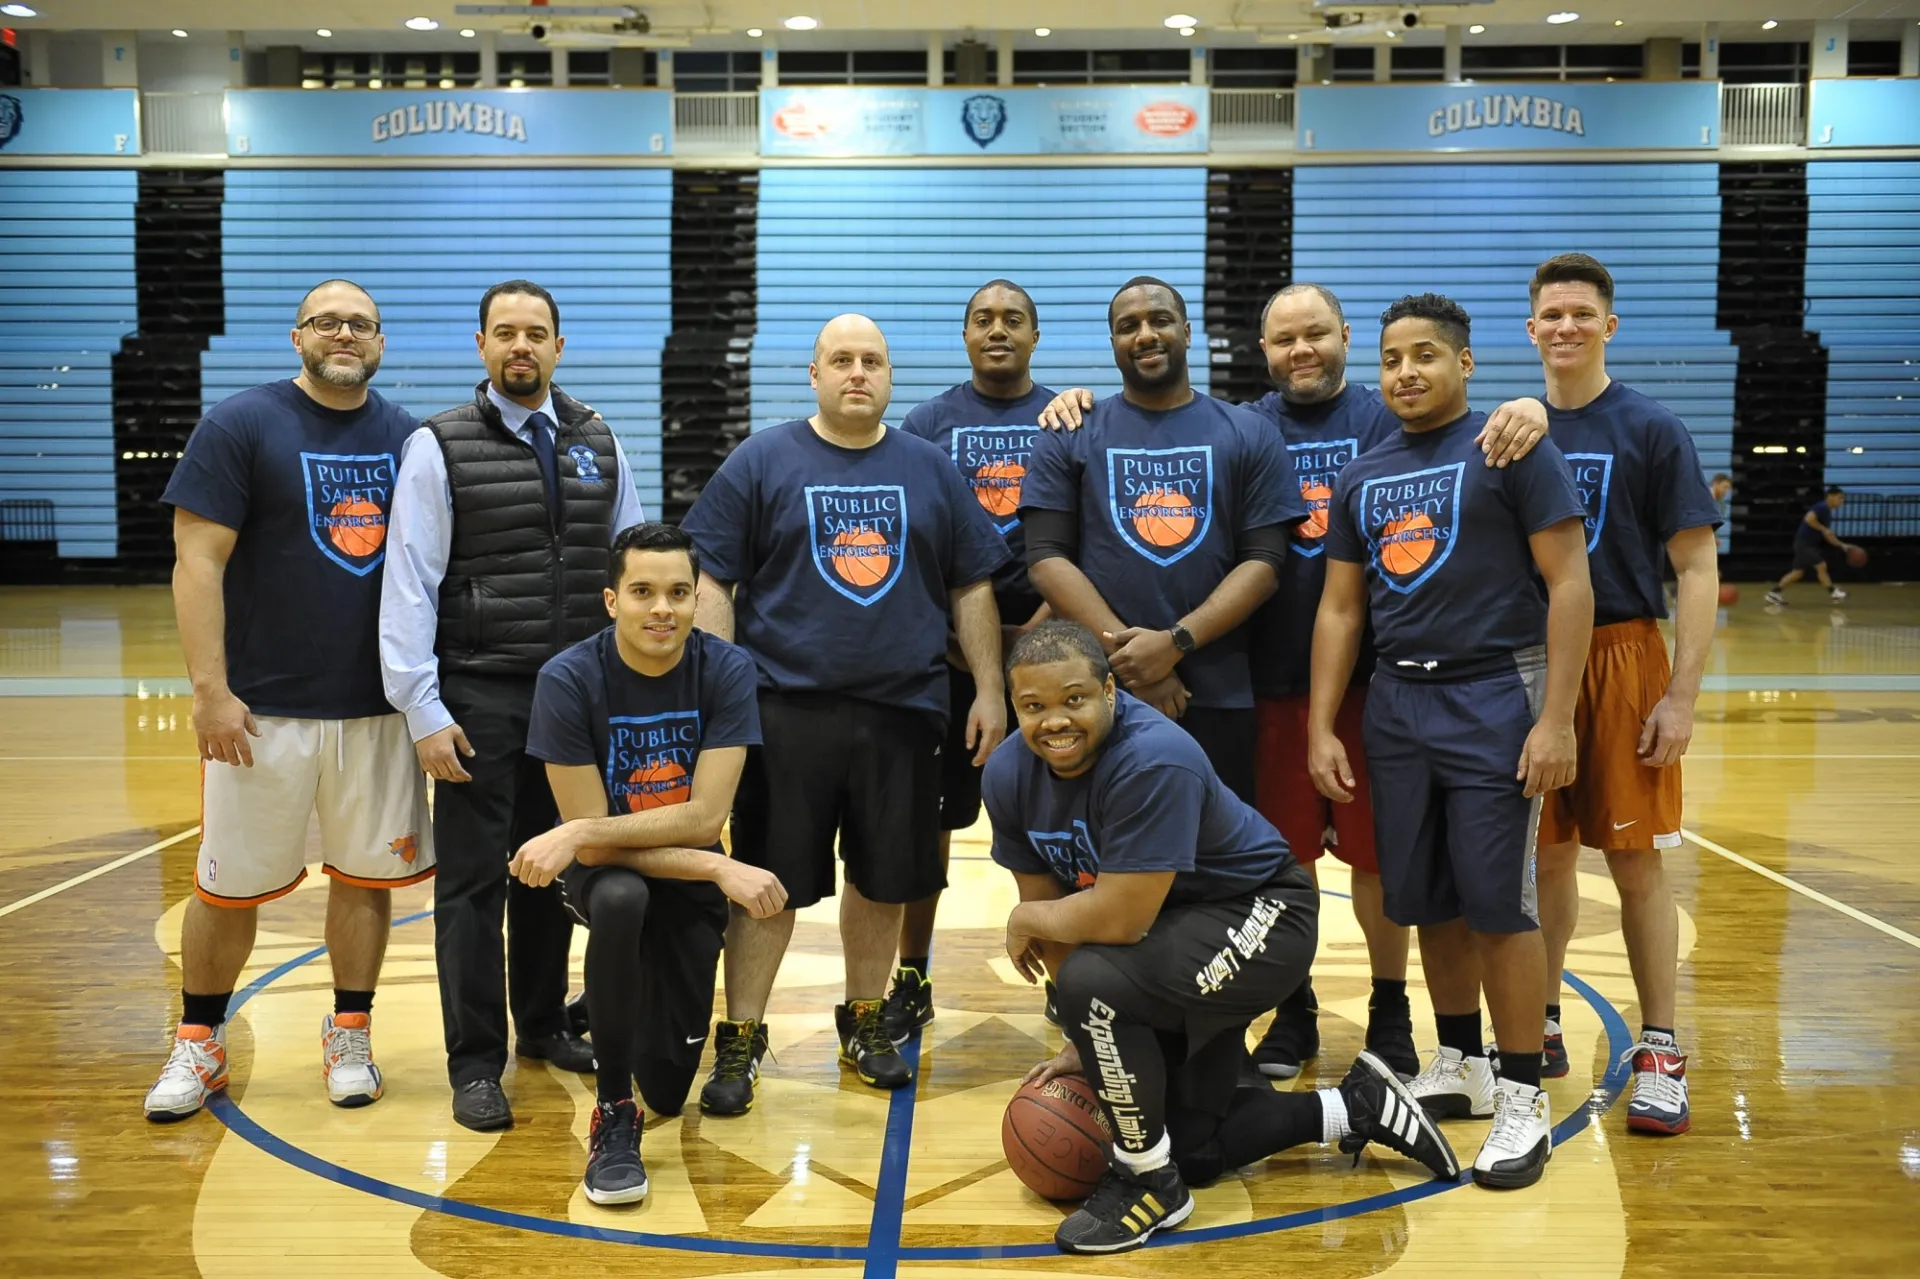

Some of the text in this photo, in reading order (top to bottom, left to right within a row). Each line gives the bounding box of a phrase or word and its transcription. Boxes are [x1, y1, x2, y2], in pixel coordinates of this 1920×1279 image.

[1826, 38, 1836, 51] J
[372, 100, 528, 143] COLUMBIA
[1428, 94, 1585, 137] COLUMBIA
[115, 134, 128, 151] F
[1818, 124, 1833, 144] J
[966, 451, 1031, 467] SAFET
[1122, 457, 1202, 477] PUBLIC
[1294, 451, 1347, 470] BLIC
[321, 485, 388, 505] SAFETY
[1125, 478, 1202, 496] SAFETY
[1373, 476, 1451, 505] PUBLIC
[821, 495, 897, 514] PUBLIC
[1119, 506, 1206, 519] ENFORCERS
[1372, 496, 1448, 526] SAFETY
[315, 514, 386, 527] ENFORCE
[824, 515, 896, 534] SAFETY
[820, 543, 900, 558] ENFORCERS
[616, 725, 695, 748] PUBLIC
[619, 747, 695, 770] SAFETY
[614, 775, 693, 796] ENFORCER
[1044, 835, 1089, 863] PUC
[1041, 1080, 1113, 1140] PALDING
[1111, 1105, 1149, 1150] Limits
